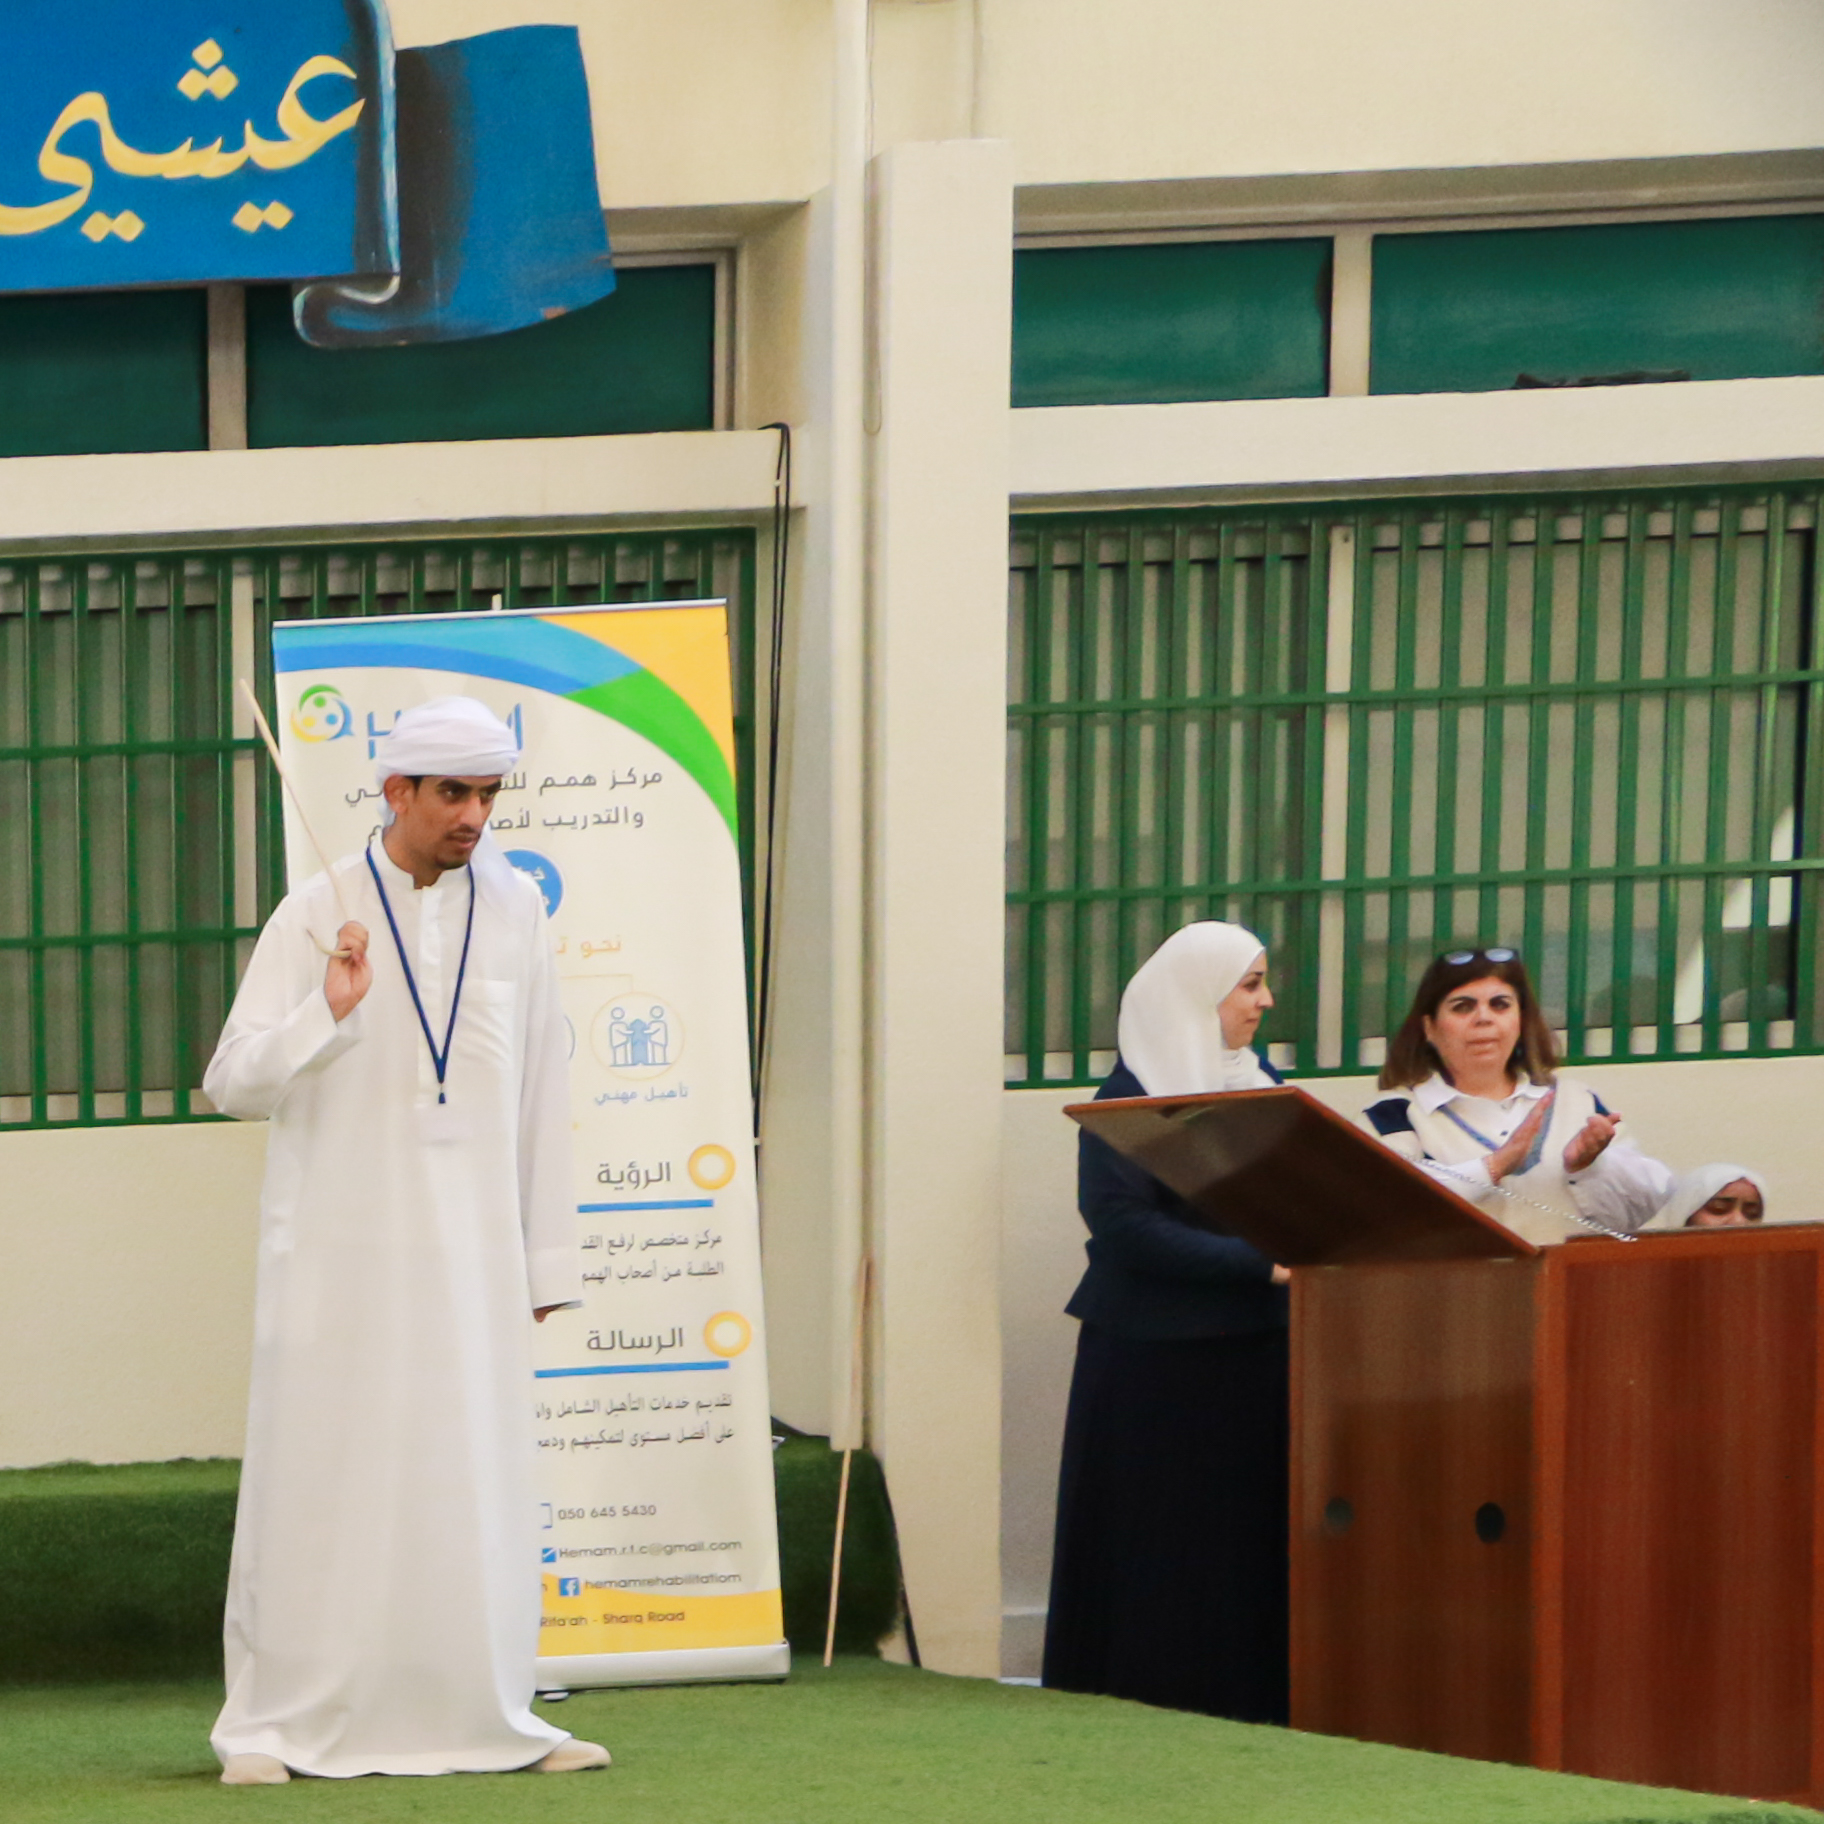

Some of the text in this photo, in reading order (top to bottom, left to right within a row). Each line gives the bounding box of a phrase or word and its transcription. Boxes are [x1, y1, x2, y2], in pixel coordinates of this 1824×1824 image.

[538, 773, 597, 796] همم
[608, 767, 663, 790] مركز
[542, 805, 644, 831] والتدريب
[644, 1081, 689, 1102] تأهيل
[596, 1160, 672, 1191] الرؤية
[694, 1228, 723, 1249] مركز
[662, 1266, 682, 1282] من
[586, 1326, 685, 1354] الرسالة
[557, 1504, 657, 1520] 050 645 5430
[647, 1610, 686, 1622] Road
